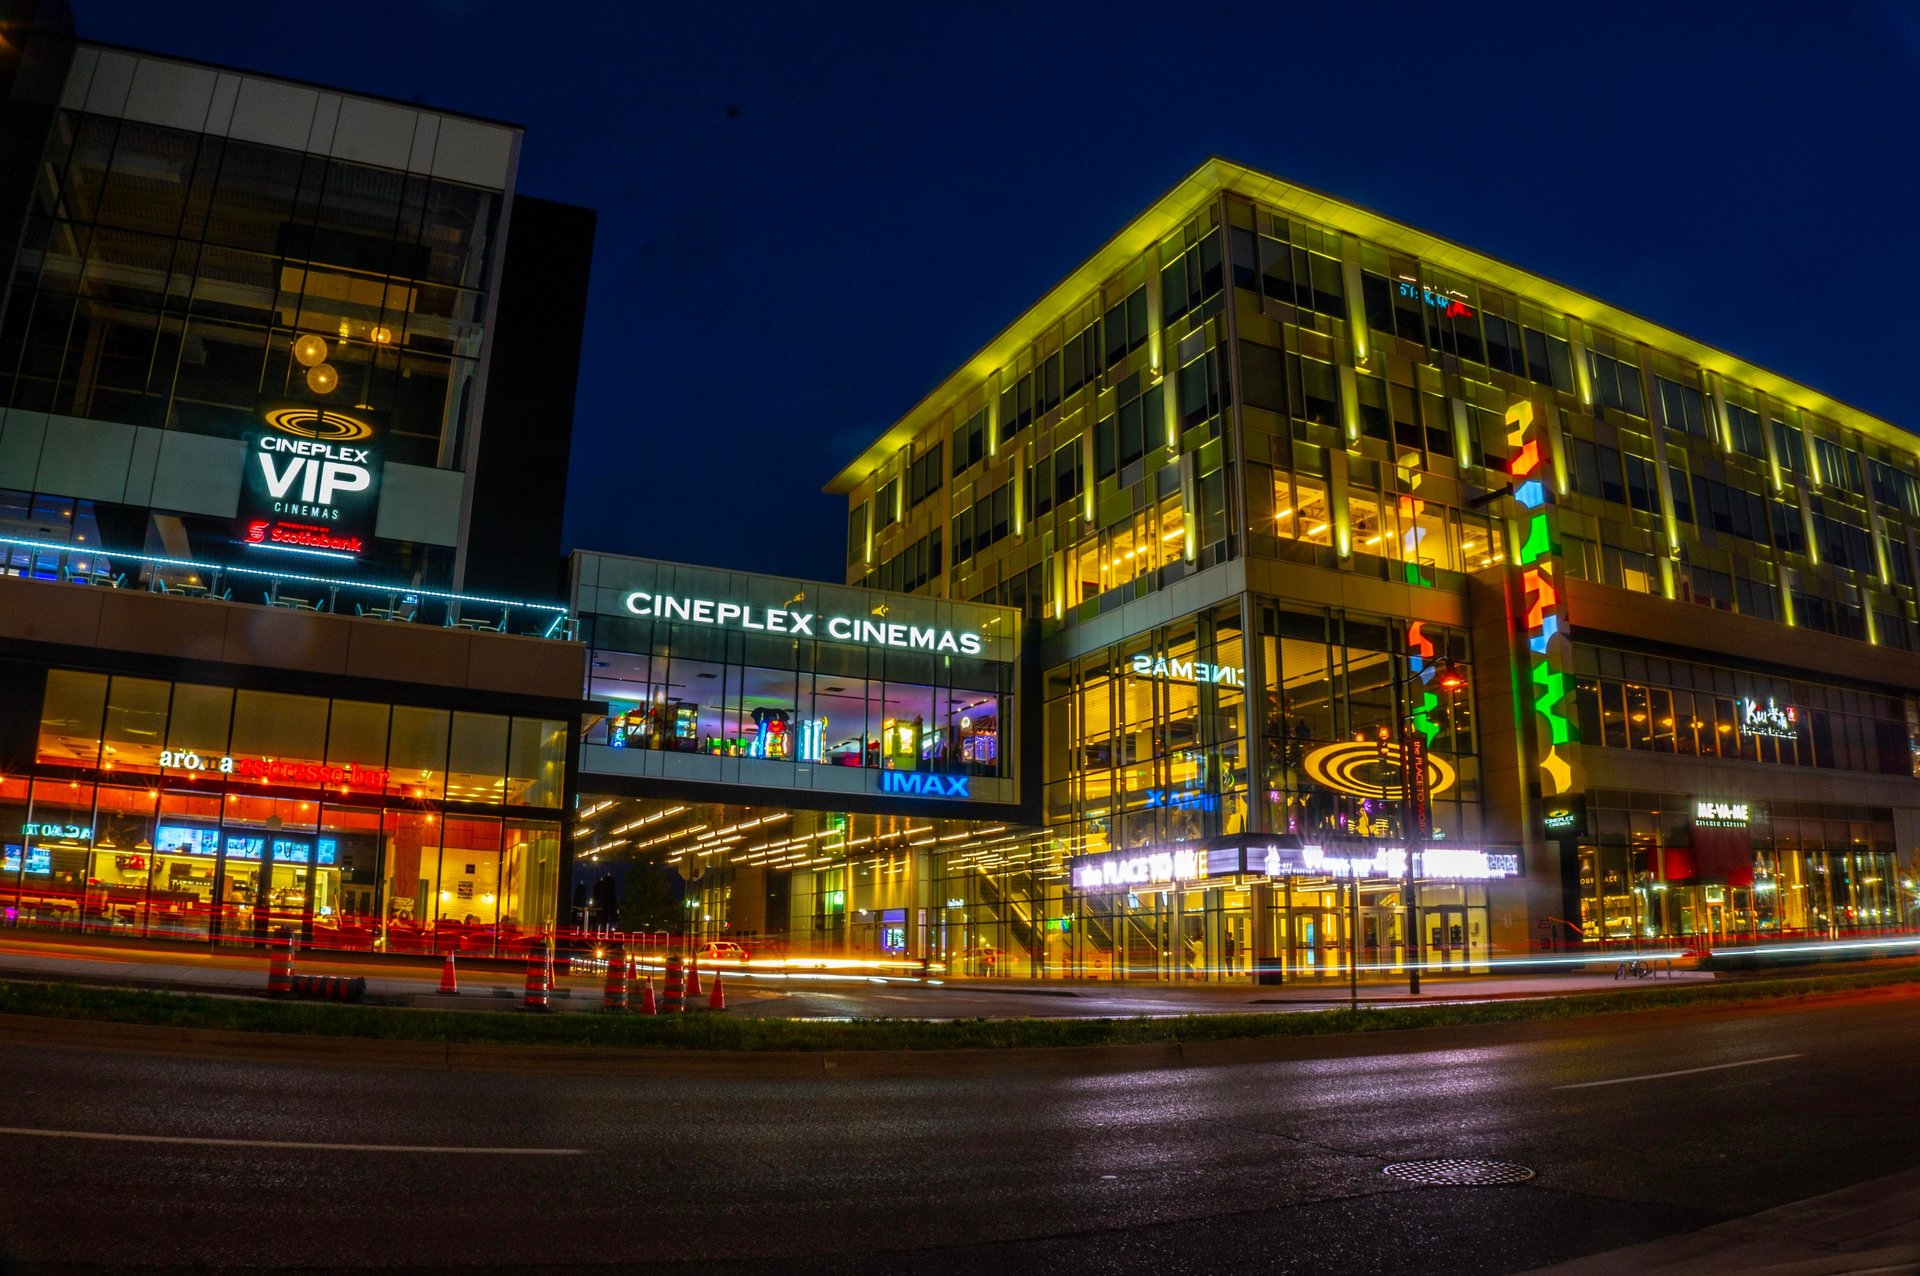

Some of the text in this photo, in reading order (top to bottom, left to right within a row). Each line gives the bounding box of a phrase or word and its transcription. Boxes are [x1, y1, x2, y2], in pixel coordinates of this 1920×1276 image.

[260, 437, 369, 464] CINEPLEX
[258, 452, 371, 505] VIP
[274, 502, 339, 520] CINEMAS
[271, 528, 363, 552] Scotiabank
[626, 592, 981, 655] CINEPLEX CINEMAS
[239, 758, 345, 784] espresso
[351, 761, 389, 788] bar
[883, 771, 970, 798] IMAX
[1415, 757, 1424, 786] PLACE
[1417, 788, 1425, 801] TO
